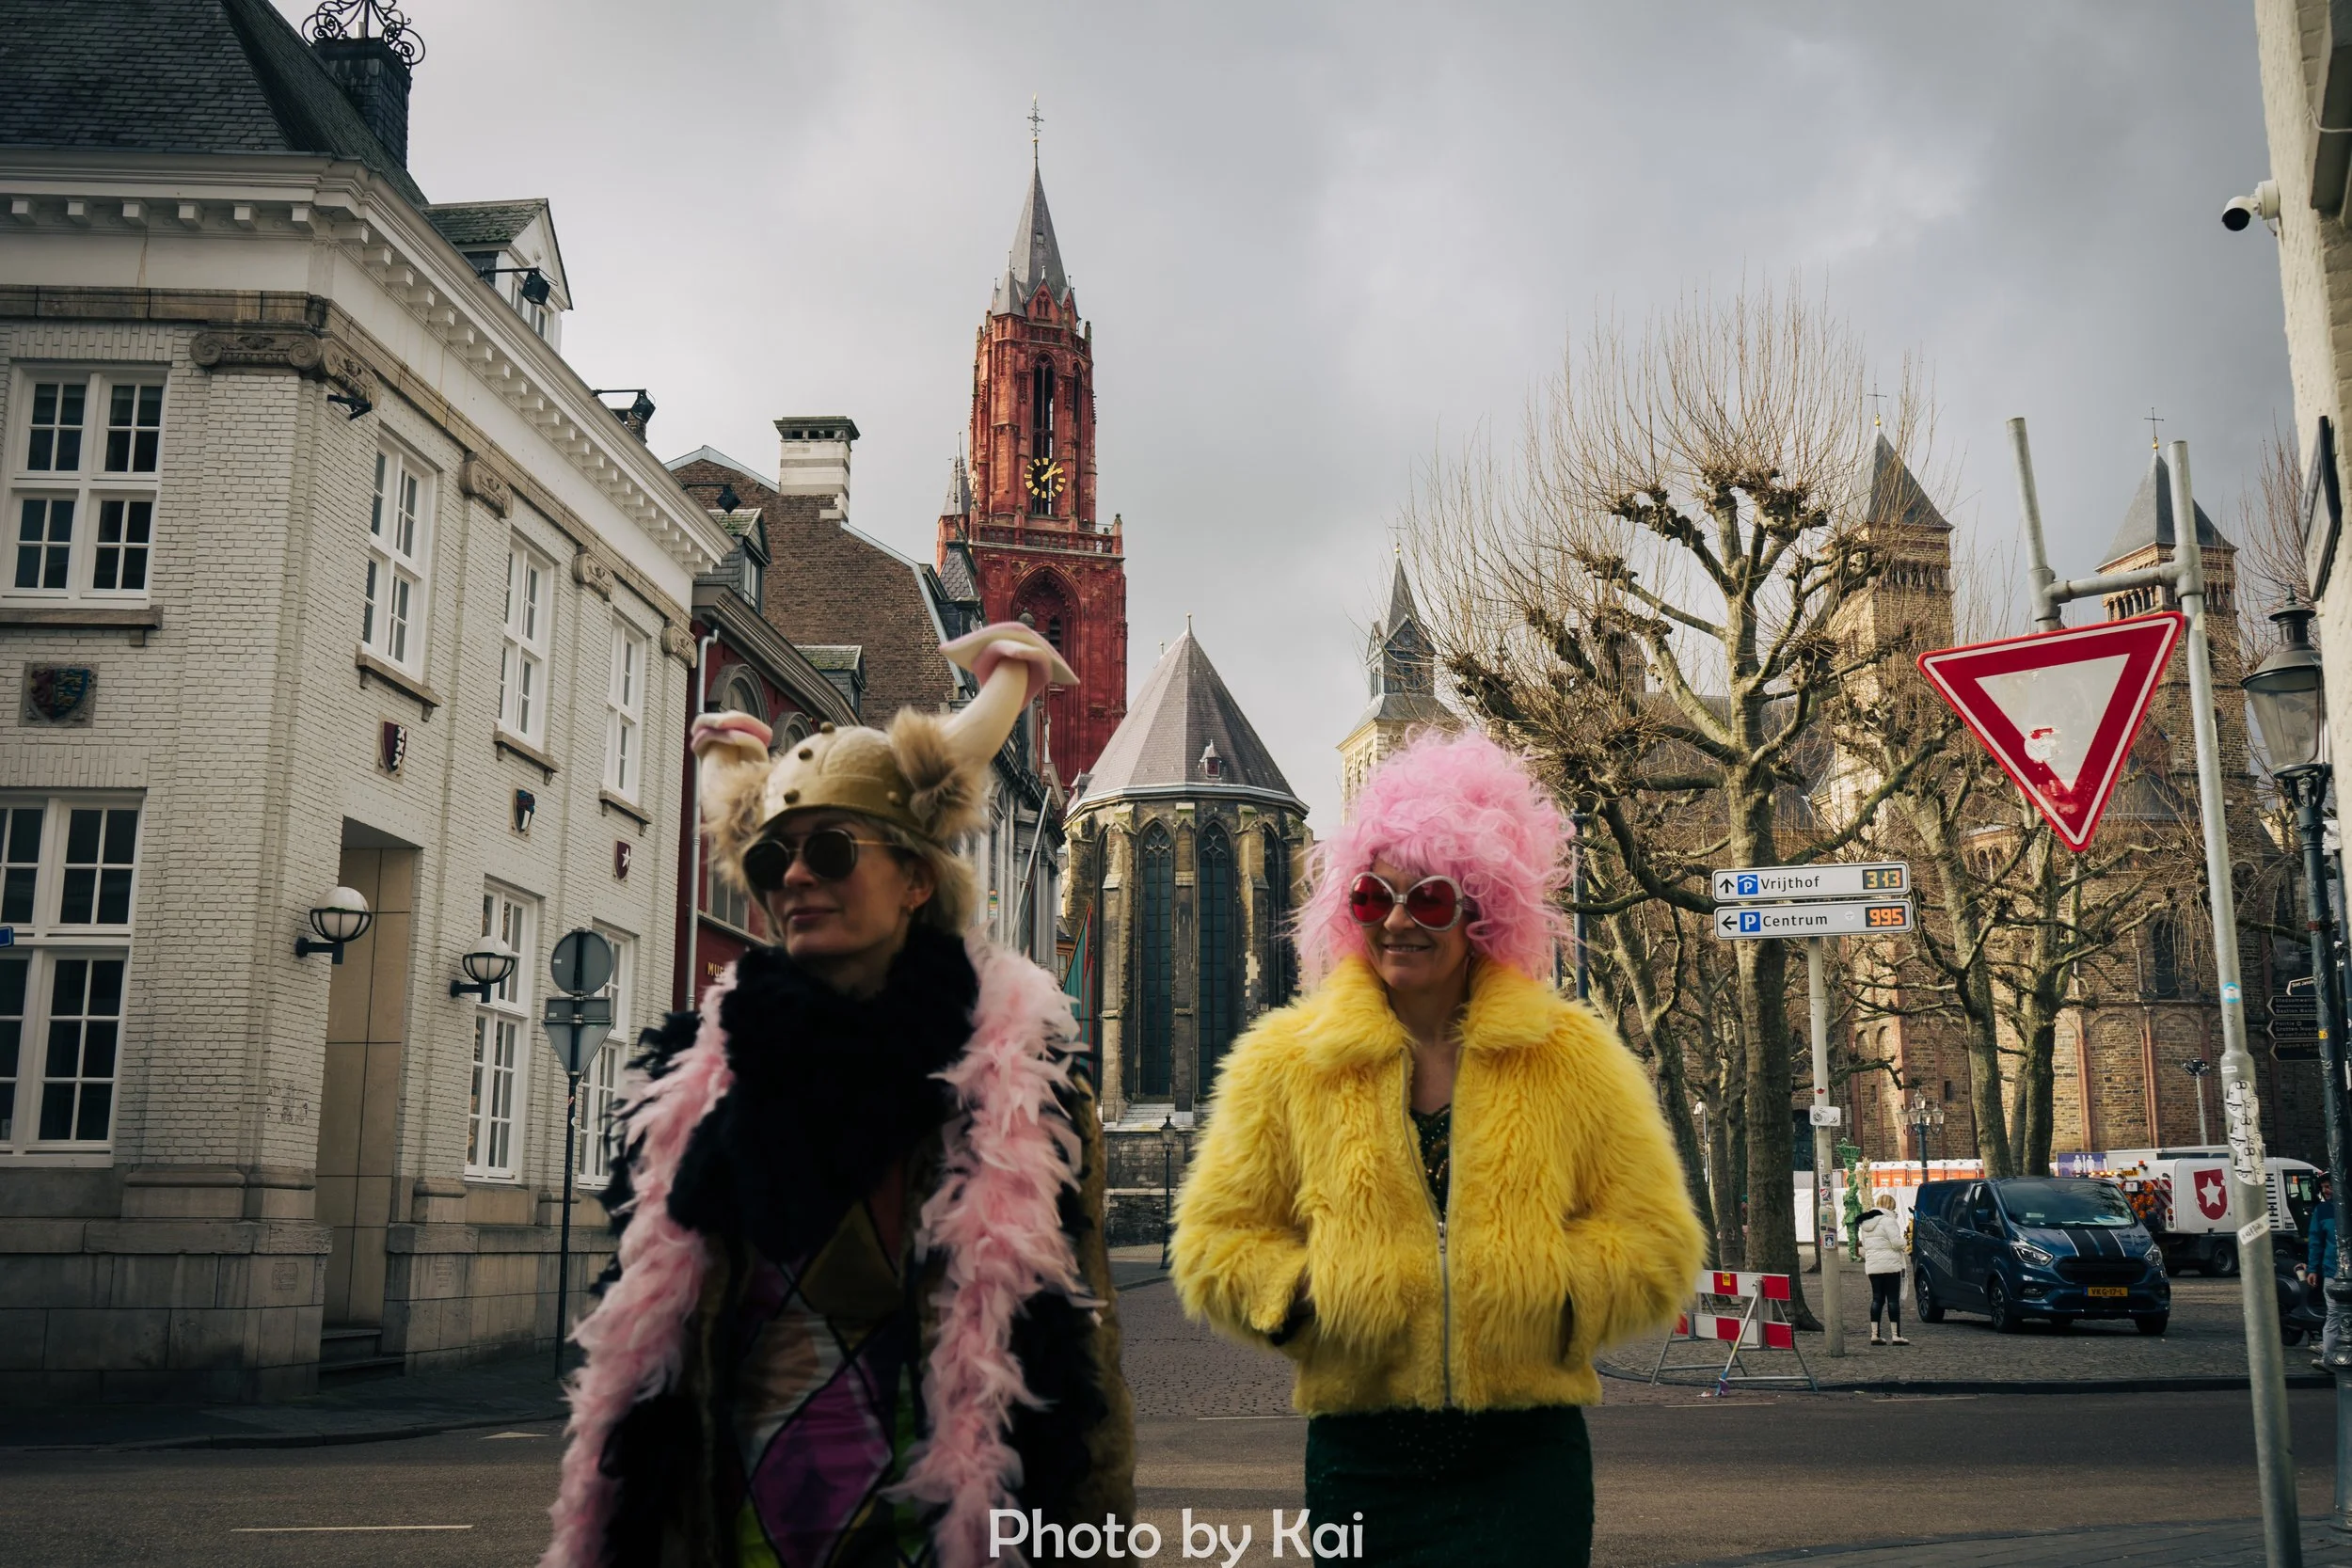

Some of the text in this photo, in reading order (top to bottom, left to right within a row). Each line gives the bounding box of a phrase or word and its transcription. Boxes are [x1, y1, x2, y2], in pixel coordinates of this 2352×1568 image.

[1761, 876, 1820, 893] Vrijthof
[1763, 914, 1828, 927] Centrum
[1868, 908, 1904, 927] 995
[2091, 1288, 2124, 1296] VKG-17-L
